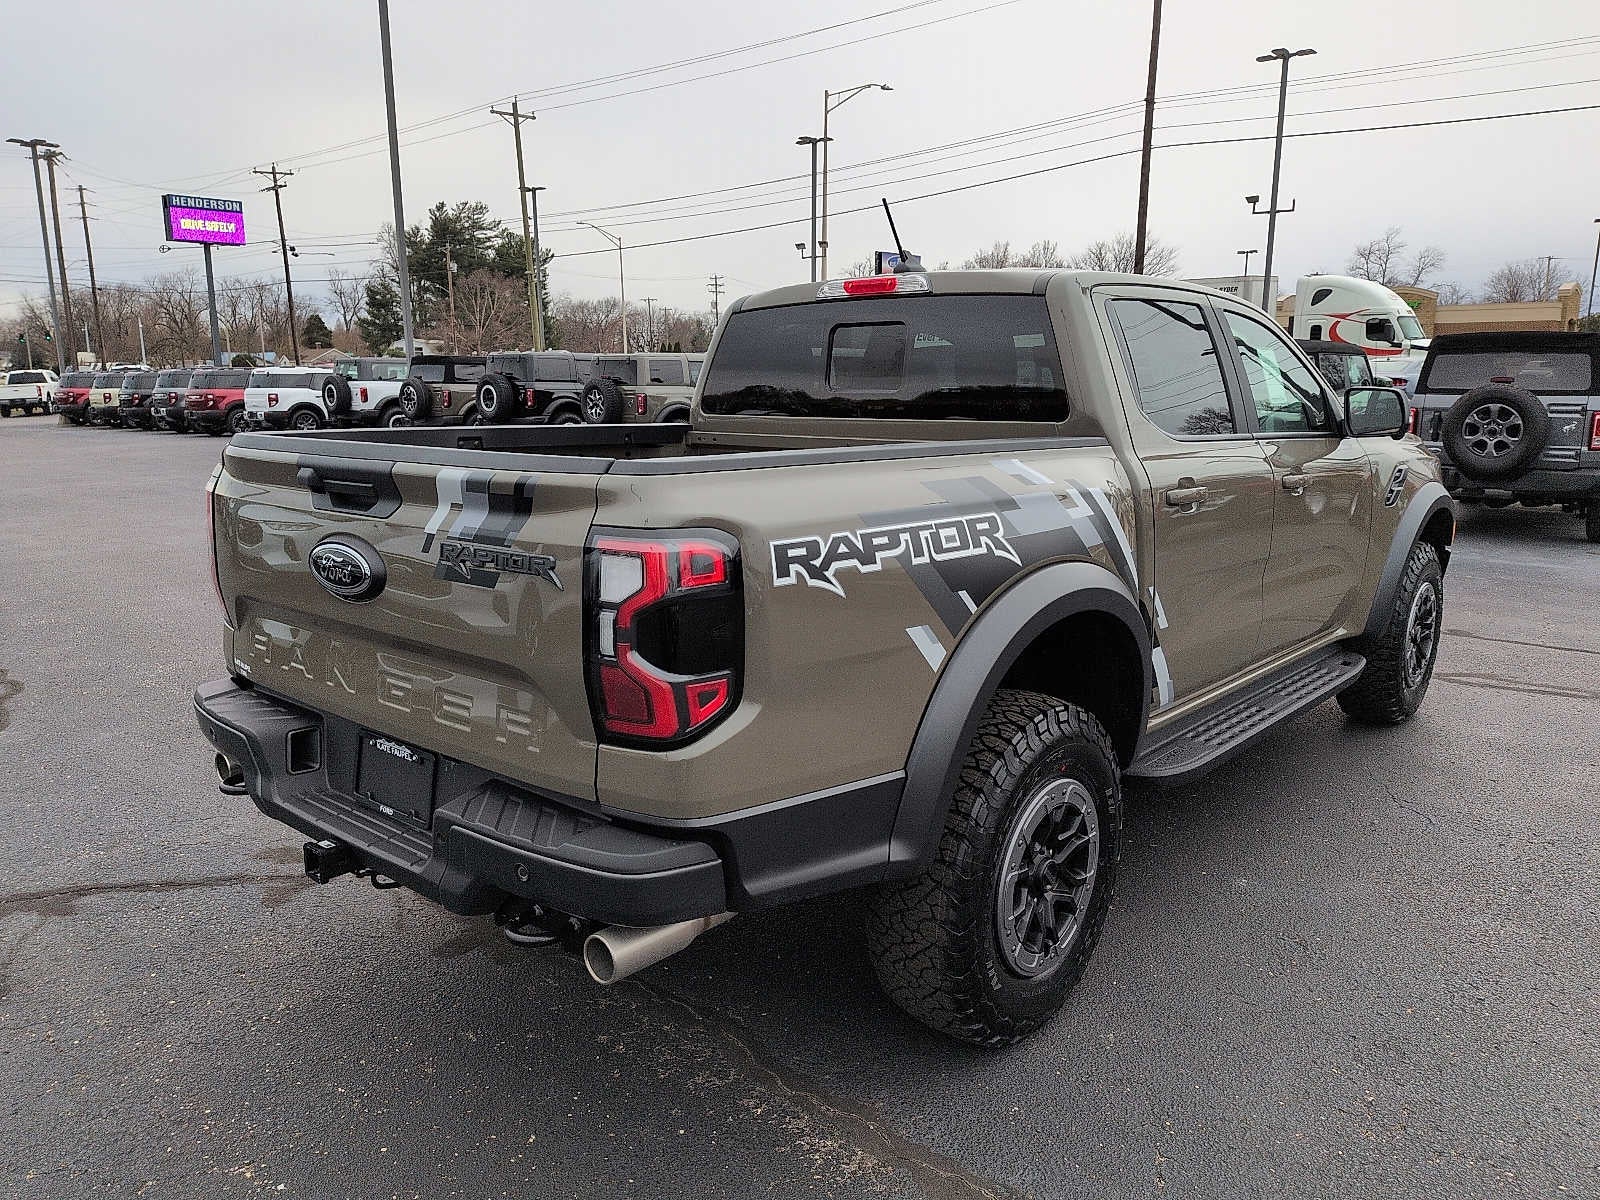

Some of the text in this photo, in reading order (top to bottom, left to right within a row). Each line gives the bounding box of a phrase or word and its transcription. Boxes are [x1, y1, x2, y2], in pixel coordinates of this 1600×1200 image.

[172, 196, 241, 211] HENDERSON
[439, 540, 565, 591] RAPTOR
[769, 512, 1022, 599] RAPTOR
[379, 805, 394, 815] FORD
